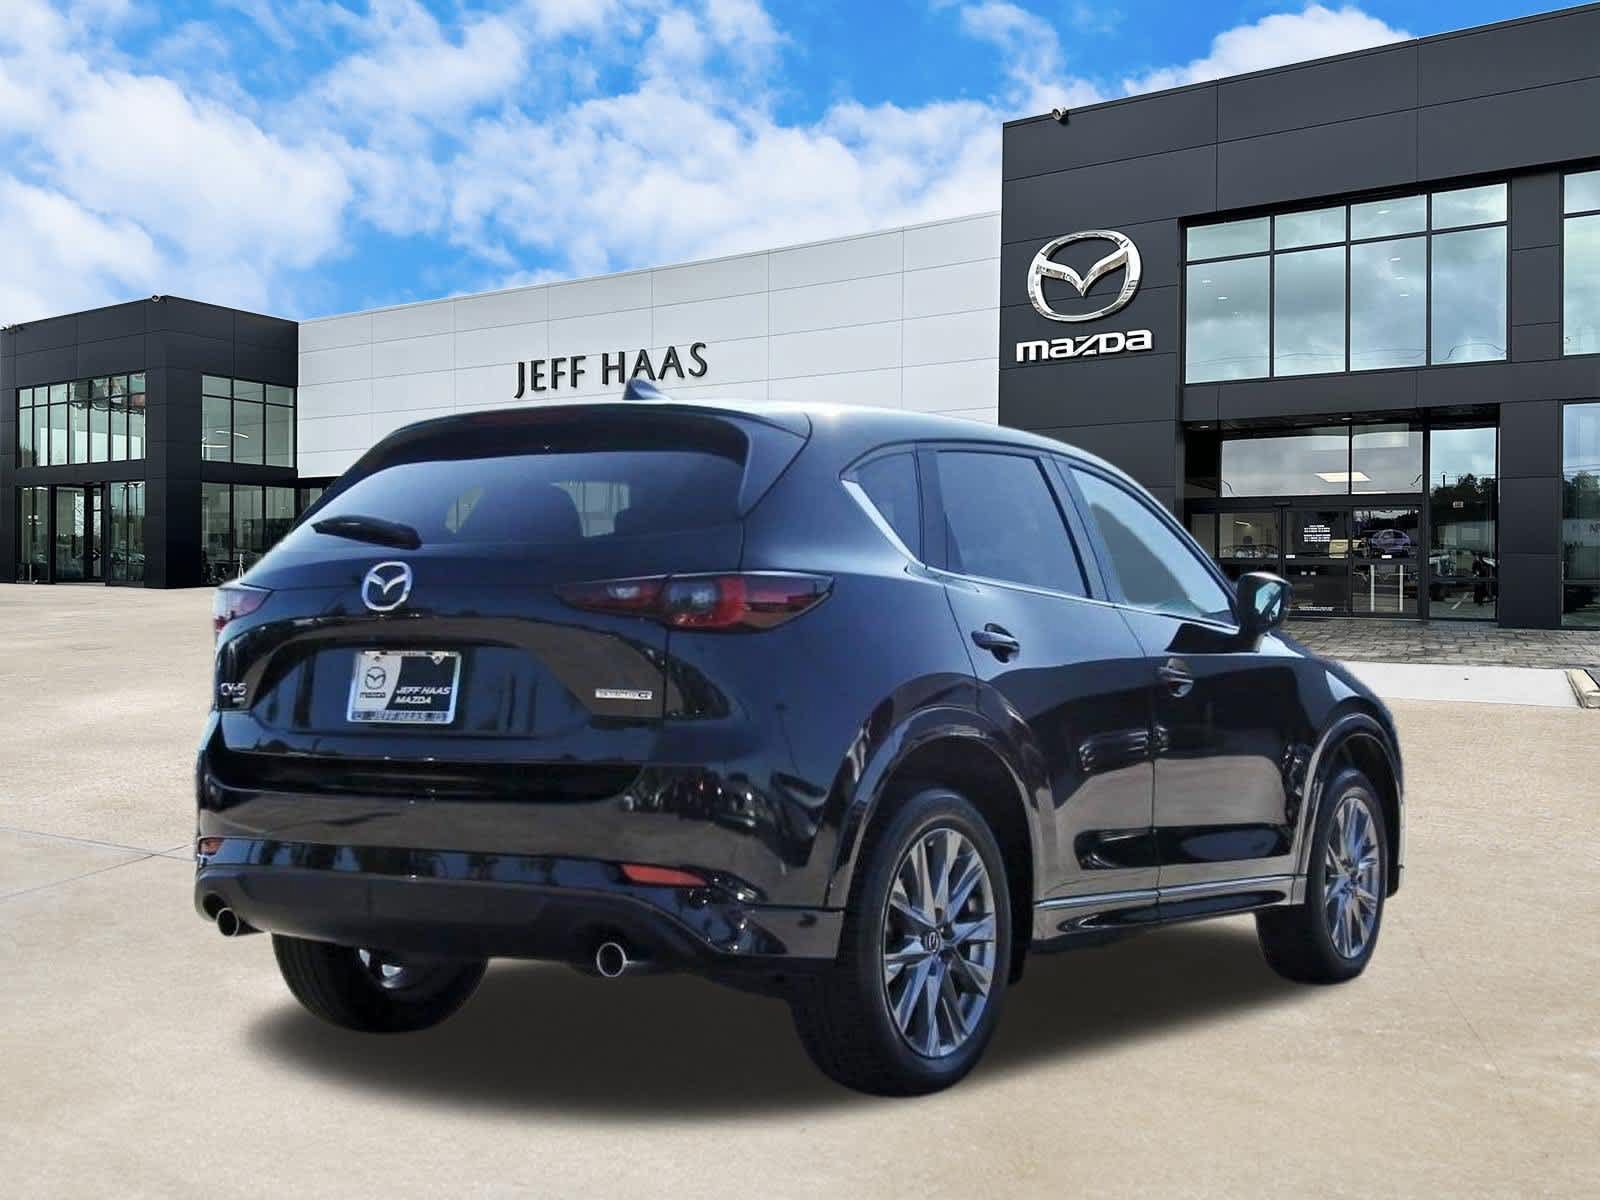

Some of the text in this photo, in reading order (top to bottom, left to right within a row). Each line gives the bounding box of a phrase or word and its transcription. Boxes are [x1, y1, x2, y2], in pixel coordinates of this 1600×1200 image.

[1016, 329, 1152, 362] mazda
[514, 342, 708, 398] JEFF HAAS
[395, 695, 432, 704] MAZDA
[396, 686, 421, 695] JEFF
[422, 686, 451, 694] HAAS
